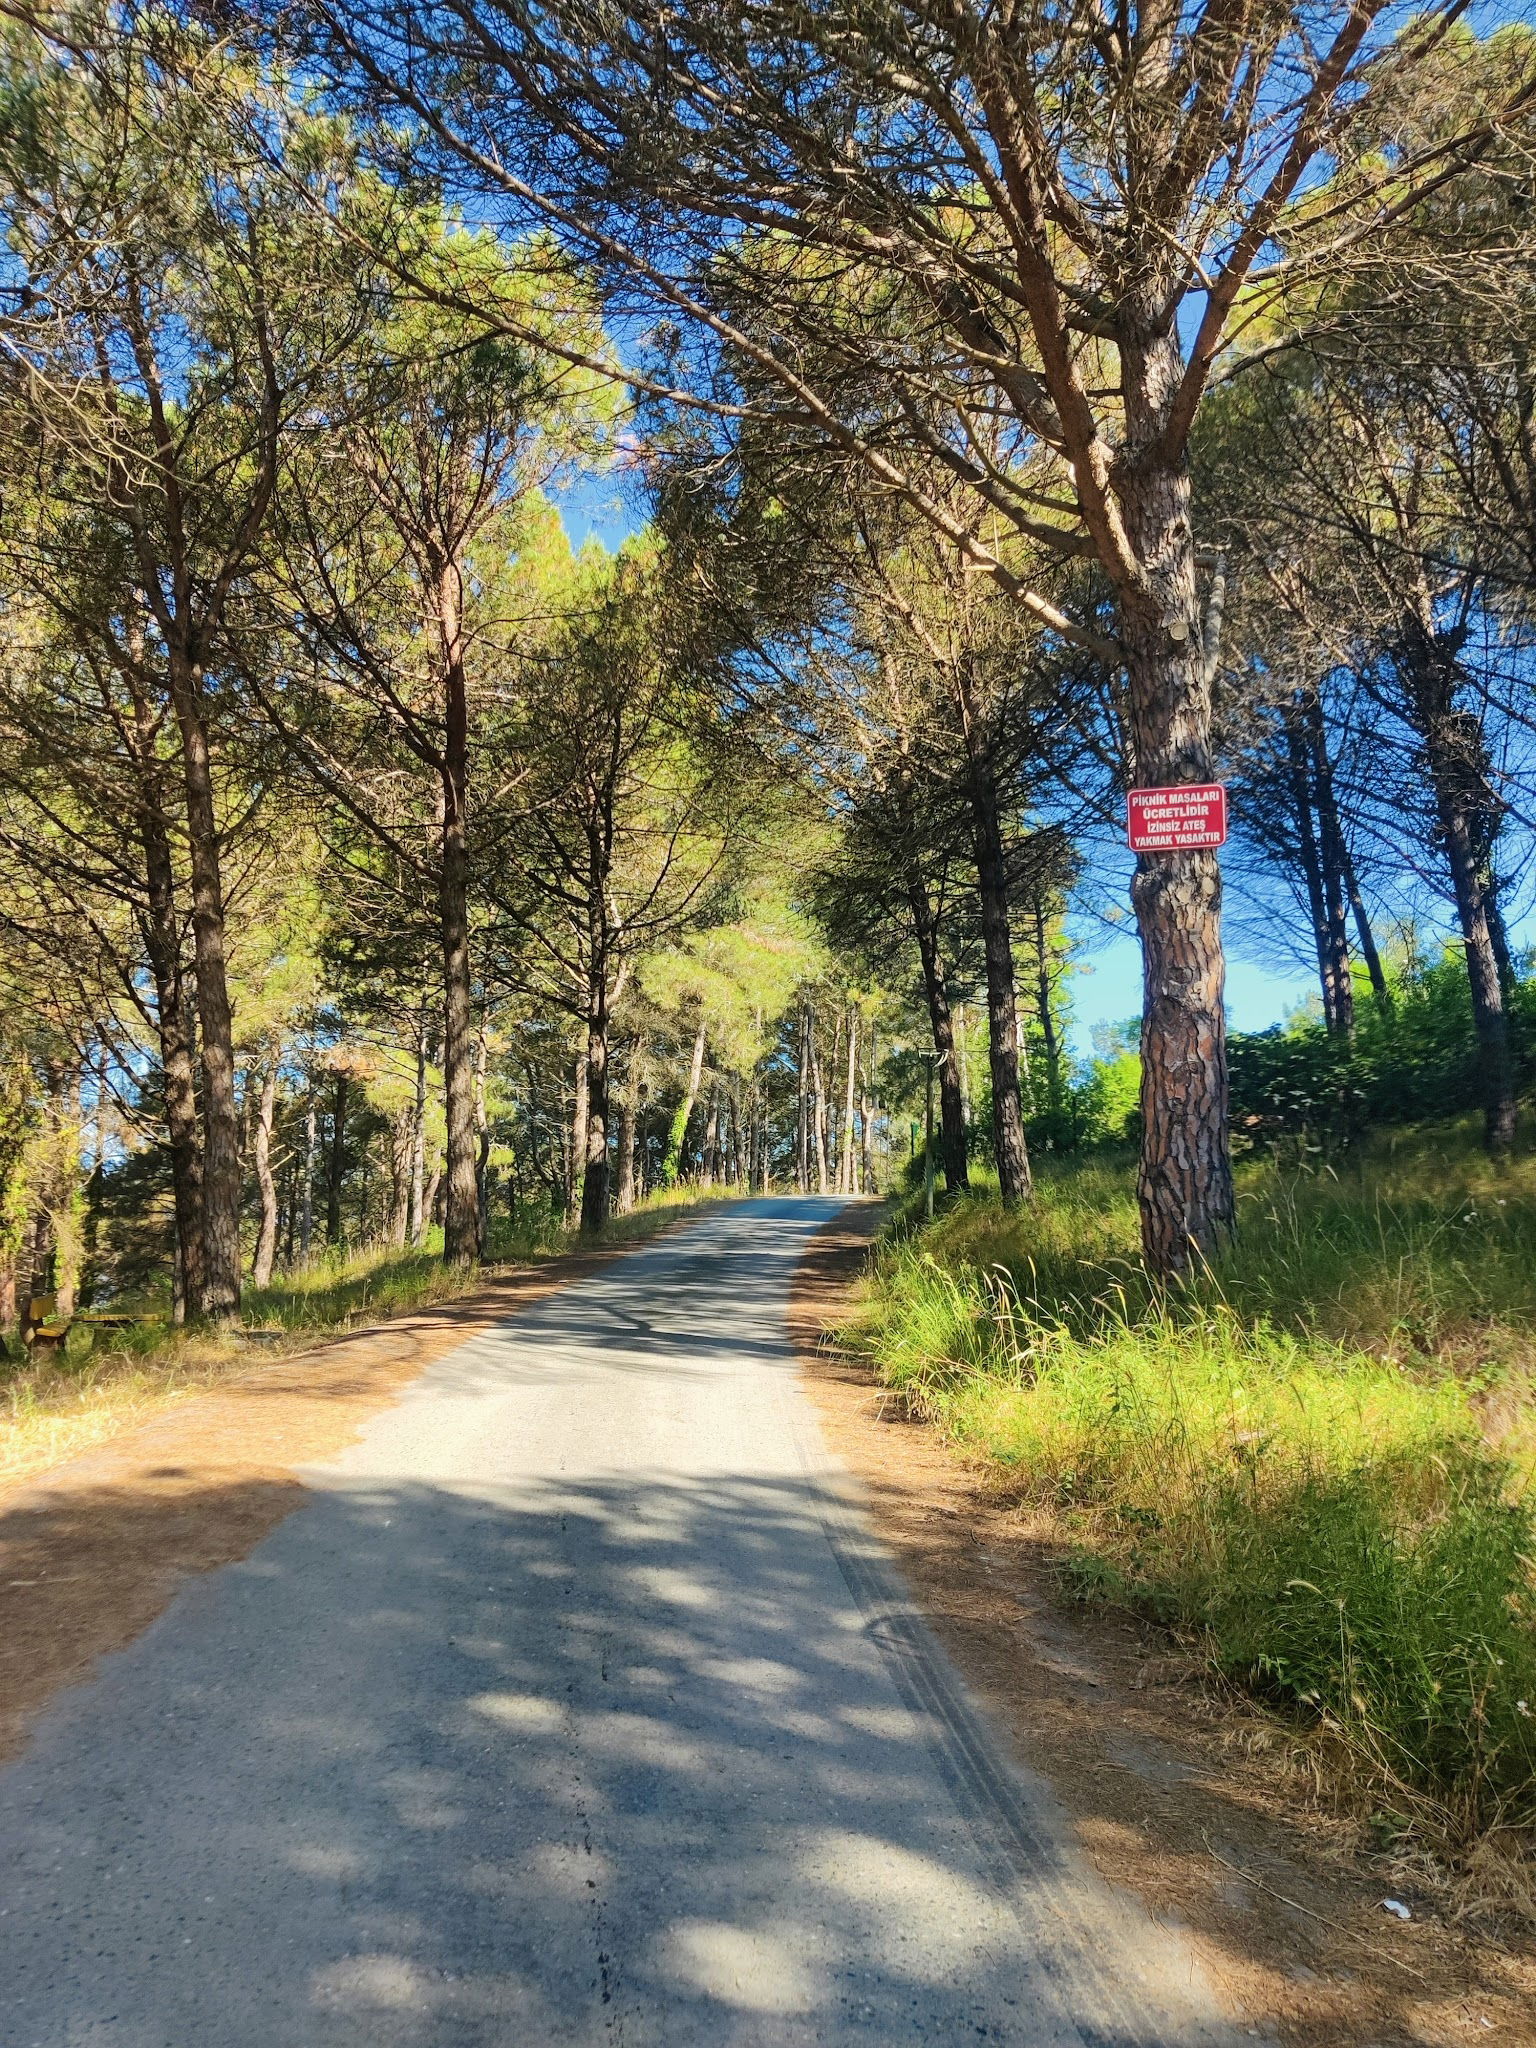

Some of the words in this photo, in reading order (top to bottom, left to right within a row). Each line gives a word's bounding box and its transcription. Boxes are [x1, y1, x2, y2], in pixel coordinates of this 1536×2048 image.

[1132, 793, 1167, 807] PİKNİK
[1169, 791, 1220, 804] MASALARI
[1182, 820, 1206, 832] ATEŞ
[1134, 835, 1173, 847] YAKMAK
[1174, 832, 1220, 844] YASAKTIR
